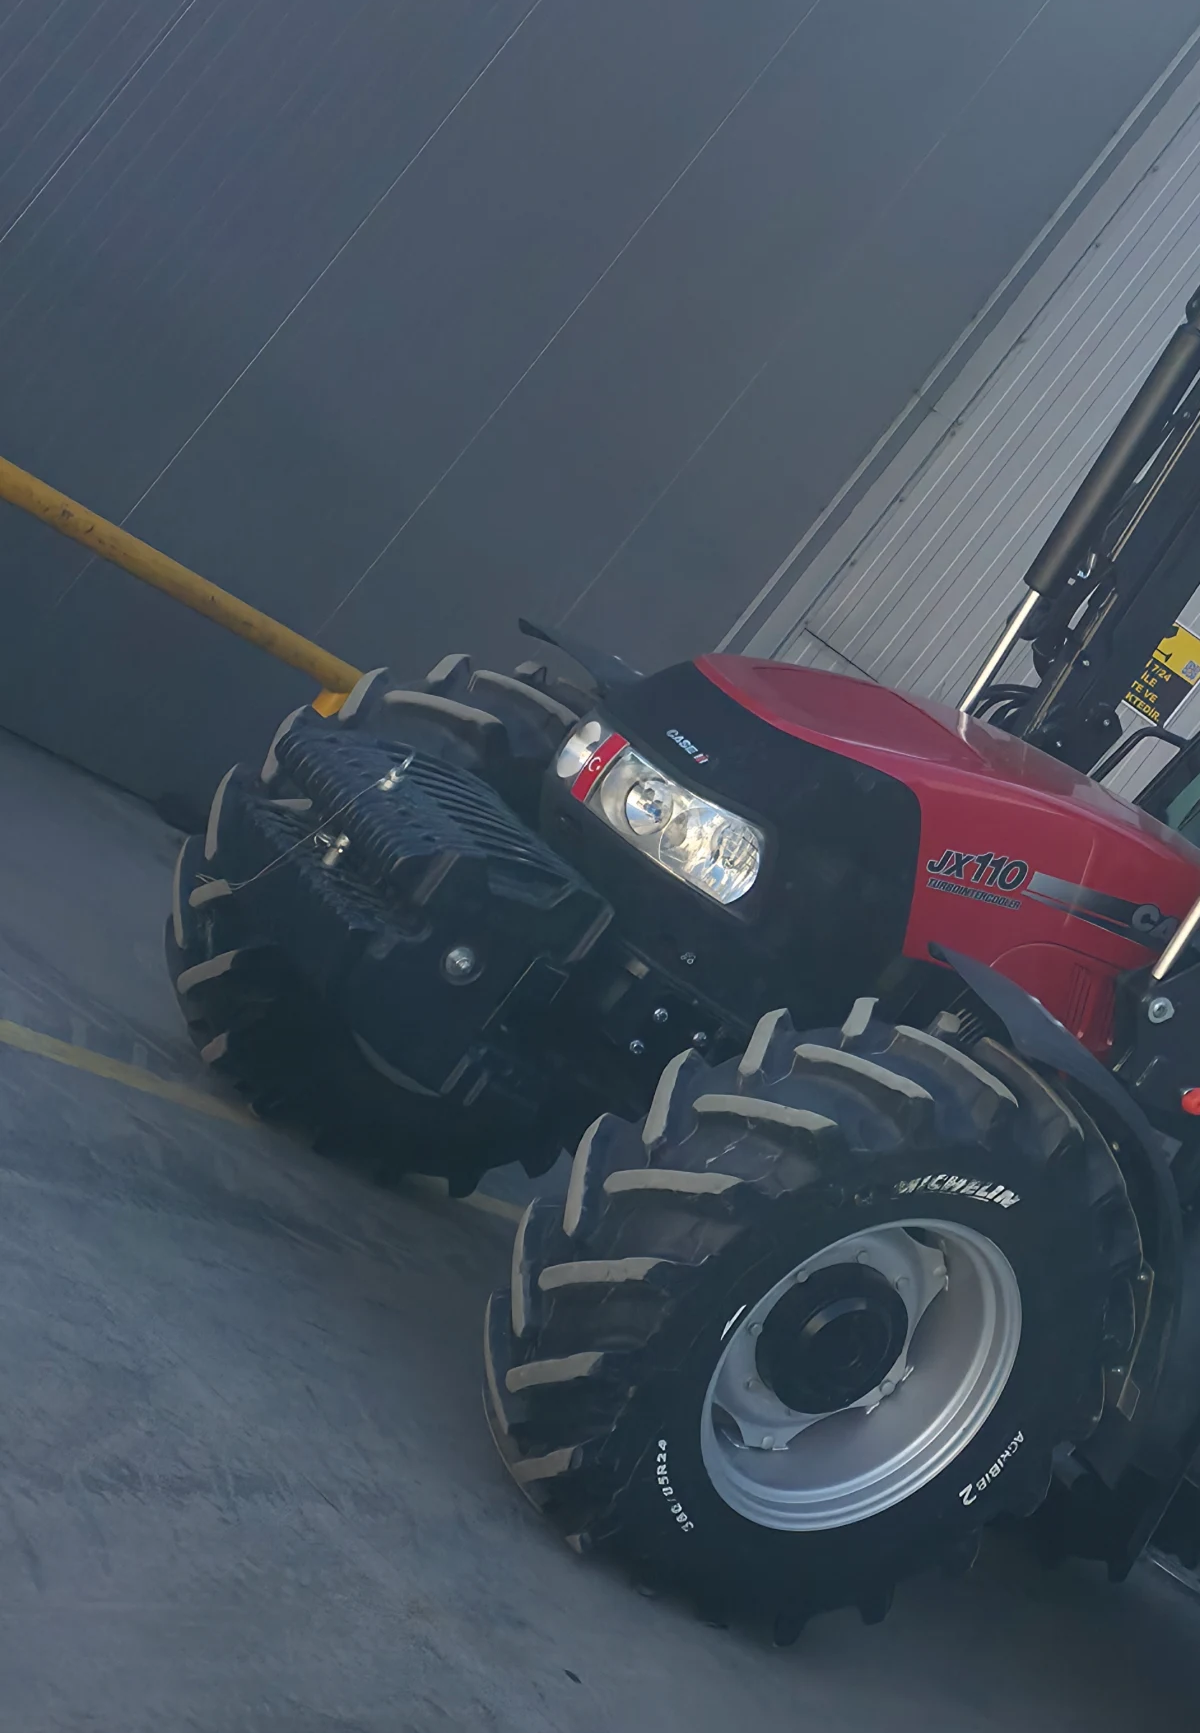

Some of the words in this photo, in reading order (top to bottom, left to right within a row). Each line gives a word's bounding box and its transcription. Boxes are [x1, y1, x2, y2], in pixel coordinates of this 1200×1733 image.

[1151, 663, 1172, 682] 7/24
[1125, 691, 1160, 722] KTEDİR.
[1144, 689, 1159, 704] VE
[666, 729, 699, 755] CASE
[1131, 903, 1180, 940] CA
[894, 1174, 1021, 1209] MICHELIN
